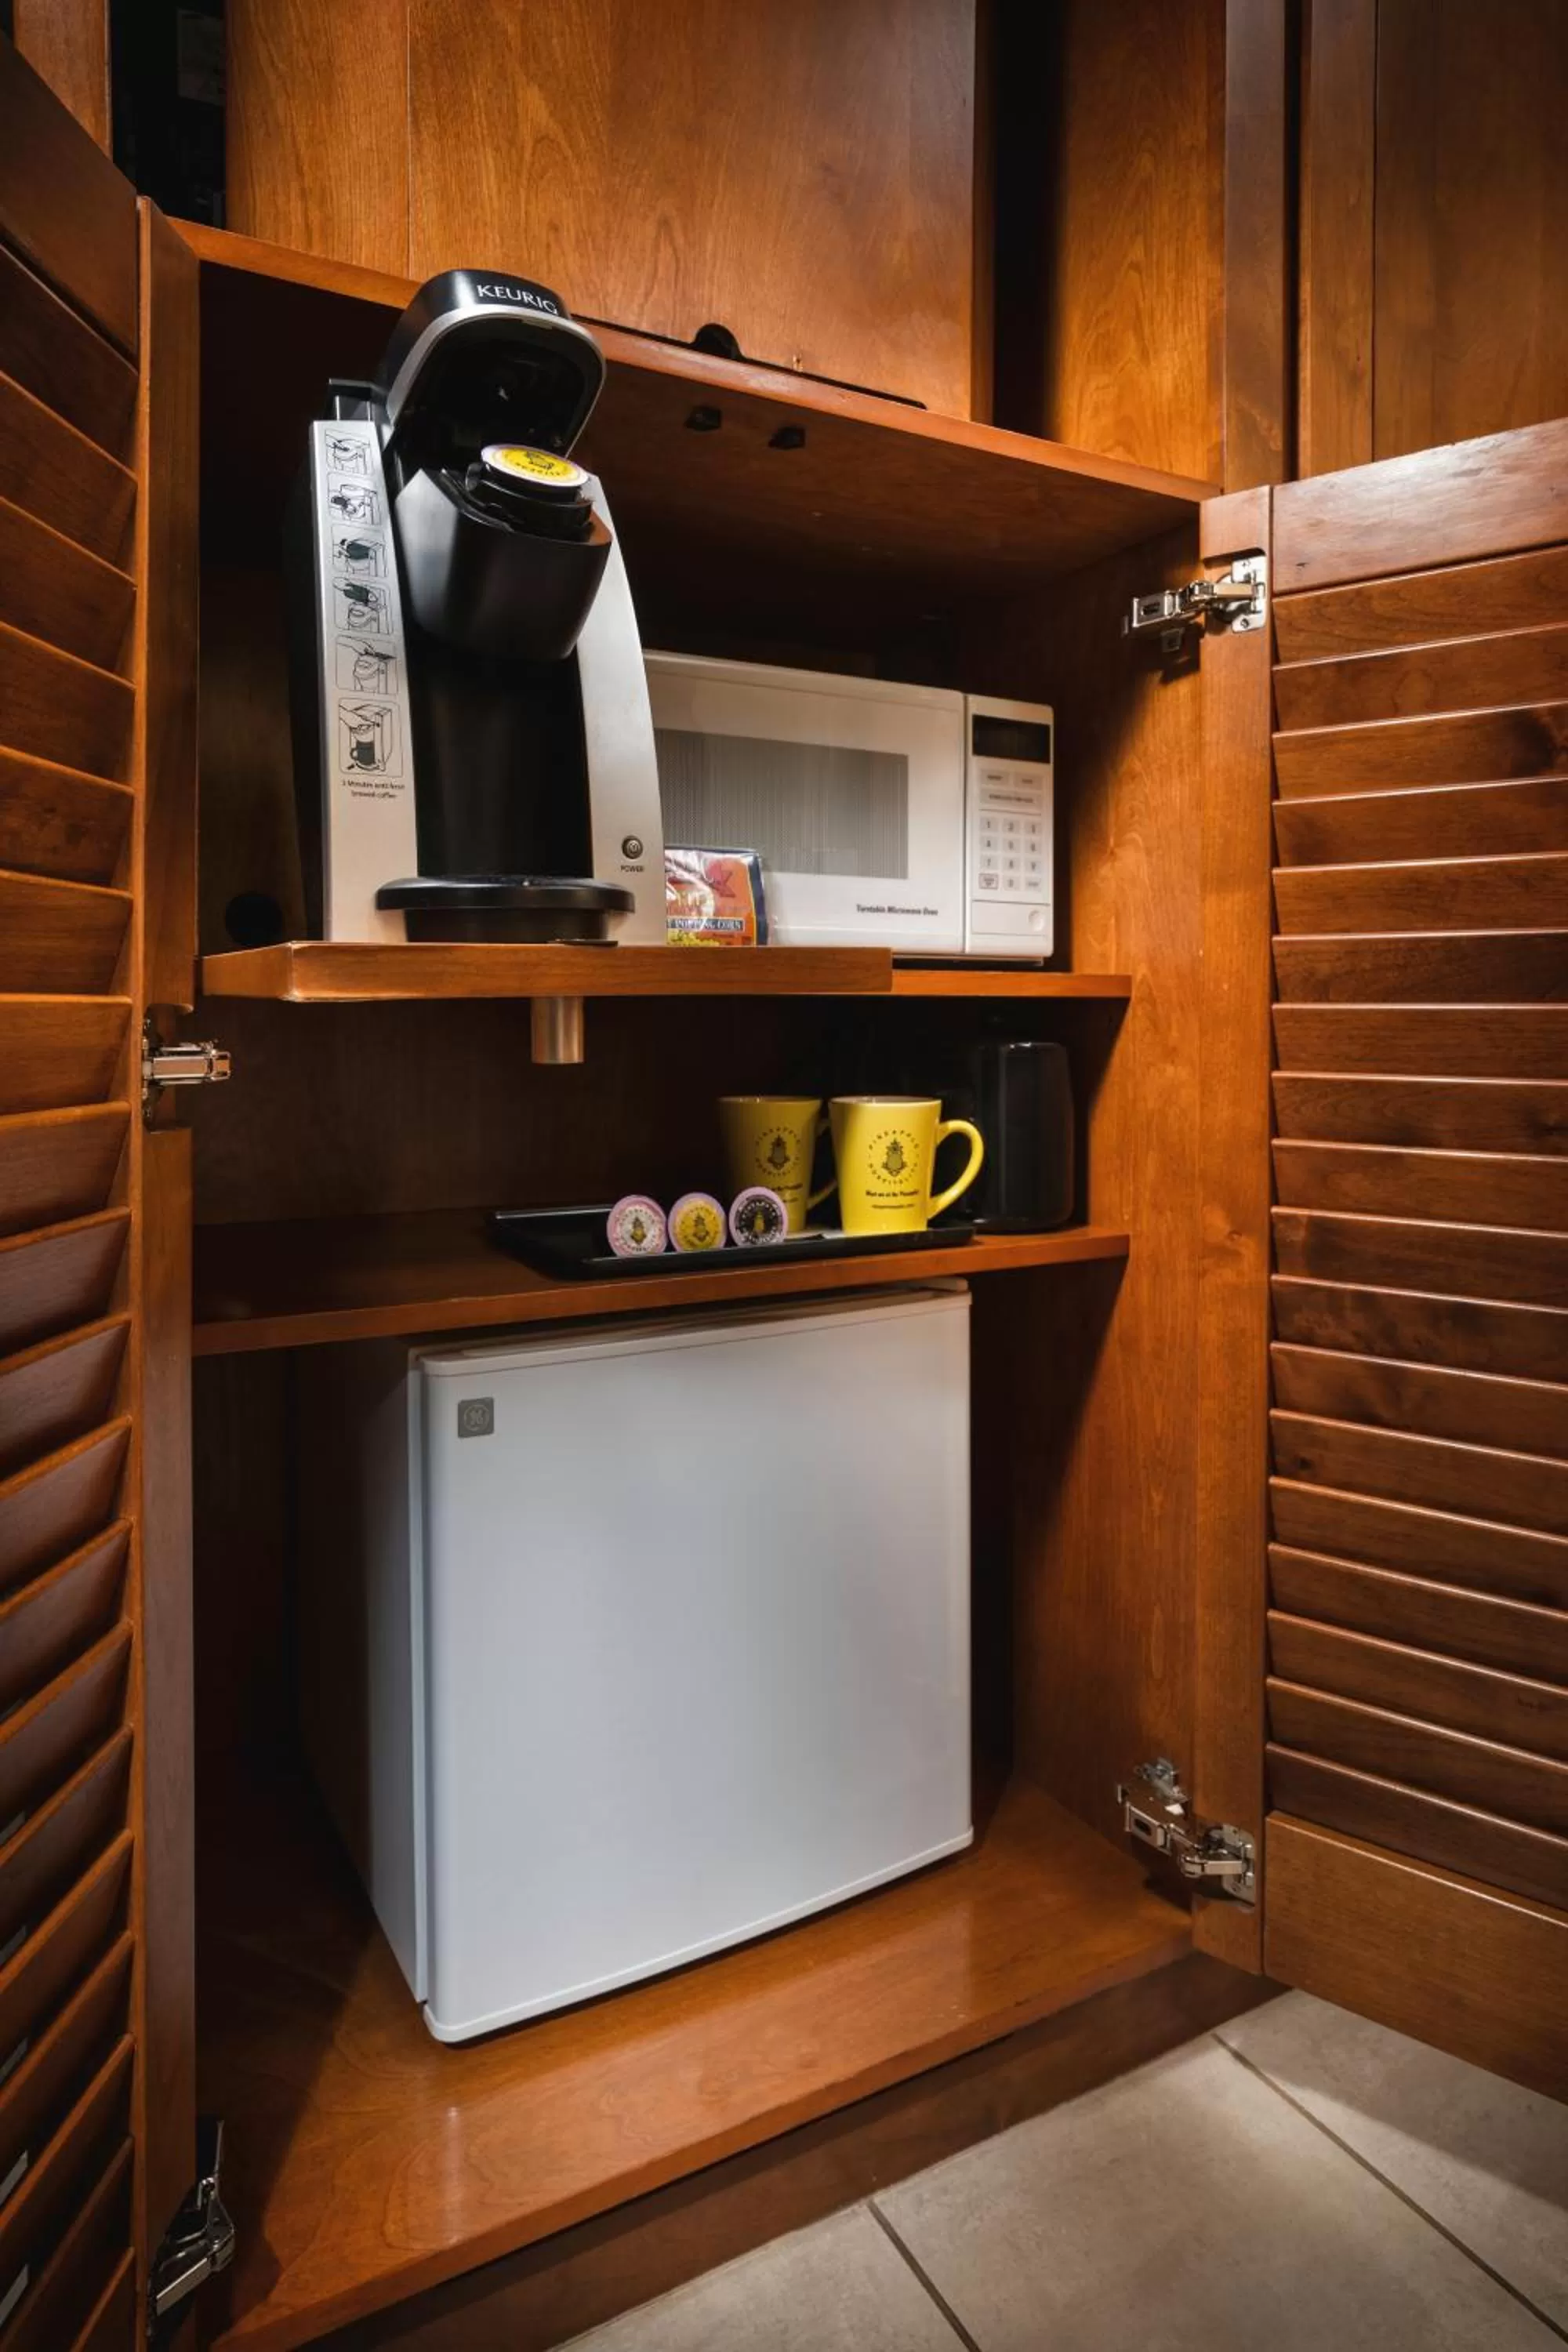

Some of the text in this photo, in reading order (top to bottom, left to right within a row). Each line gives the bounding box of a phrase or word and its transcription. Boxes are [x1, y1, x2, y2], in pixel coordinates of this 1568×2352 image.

[477, 285, 558, 315] KEURIG
[856, 903, 938, 916] Turntable Microwave Oven
